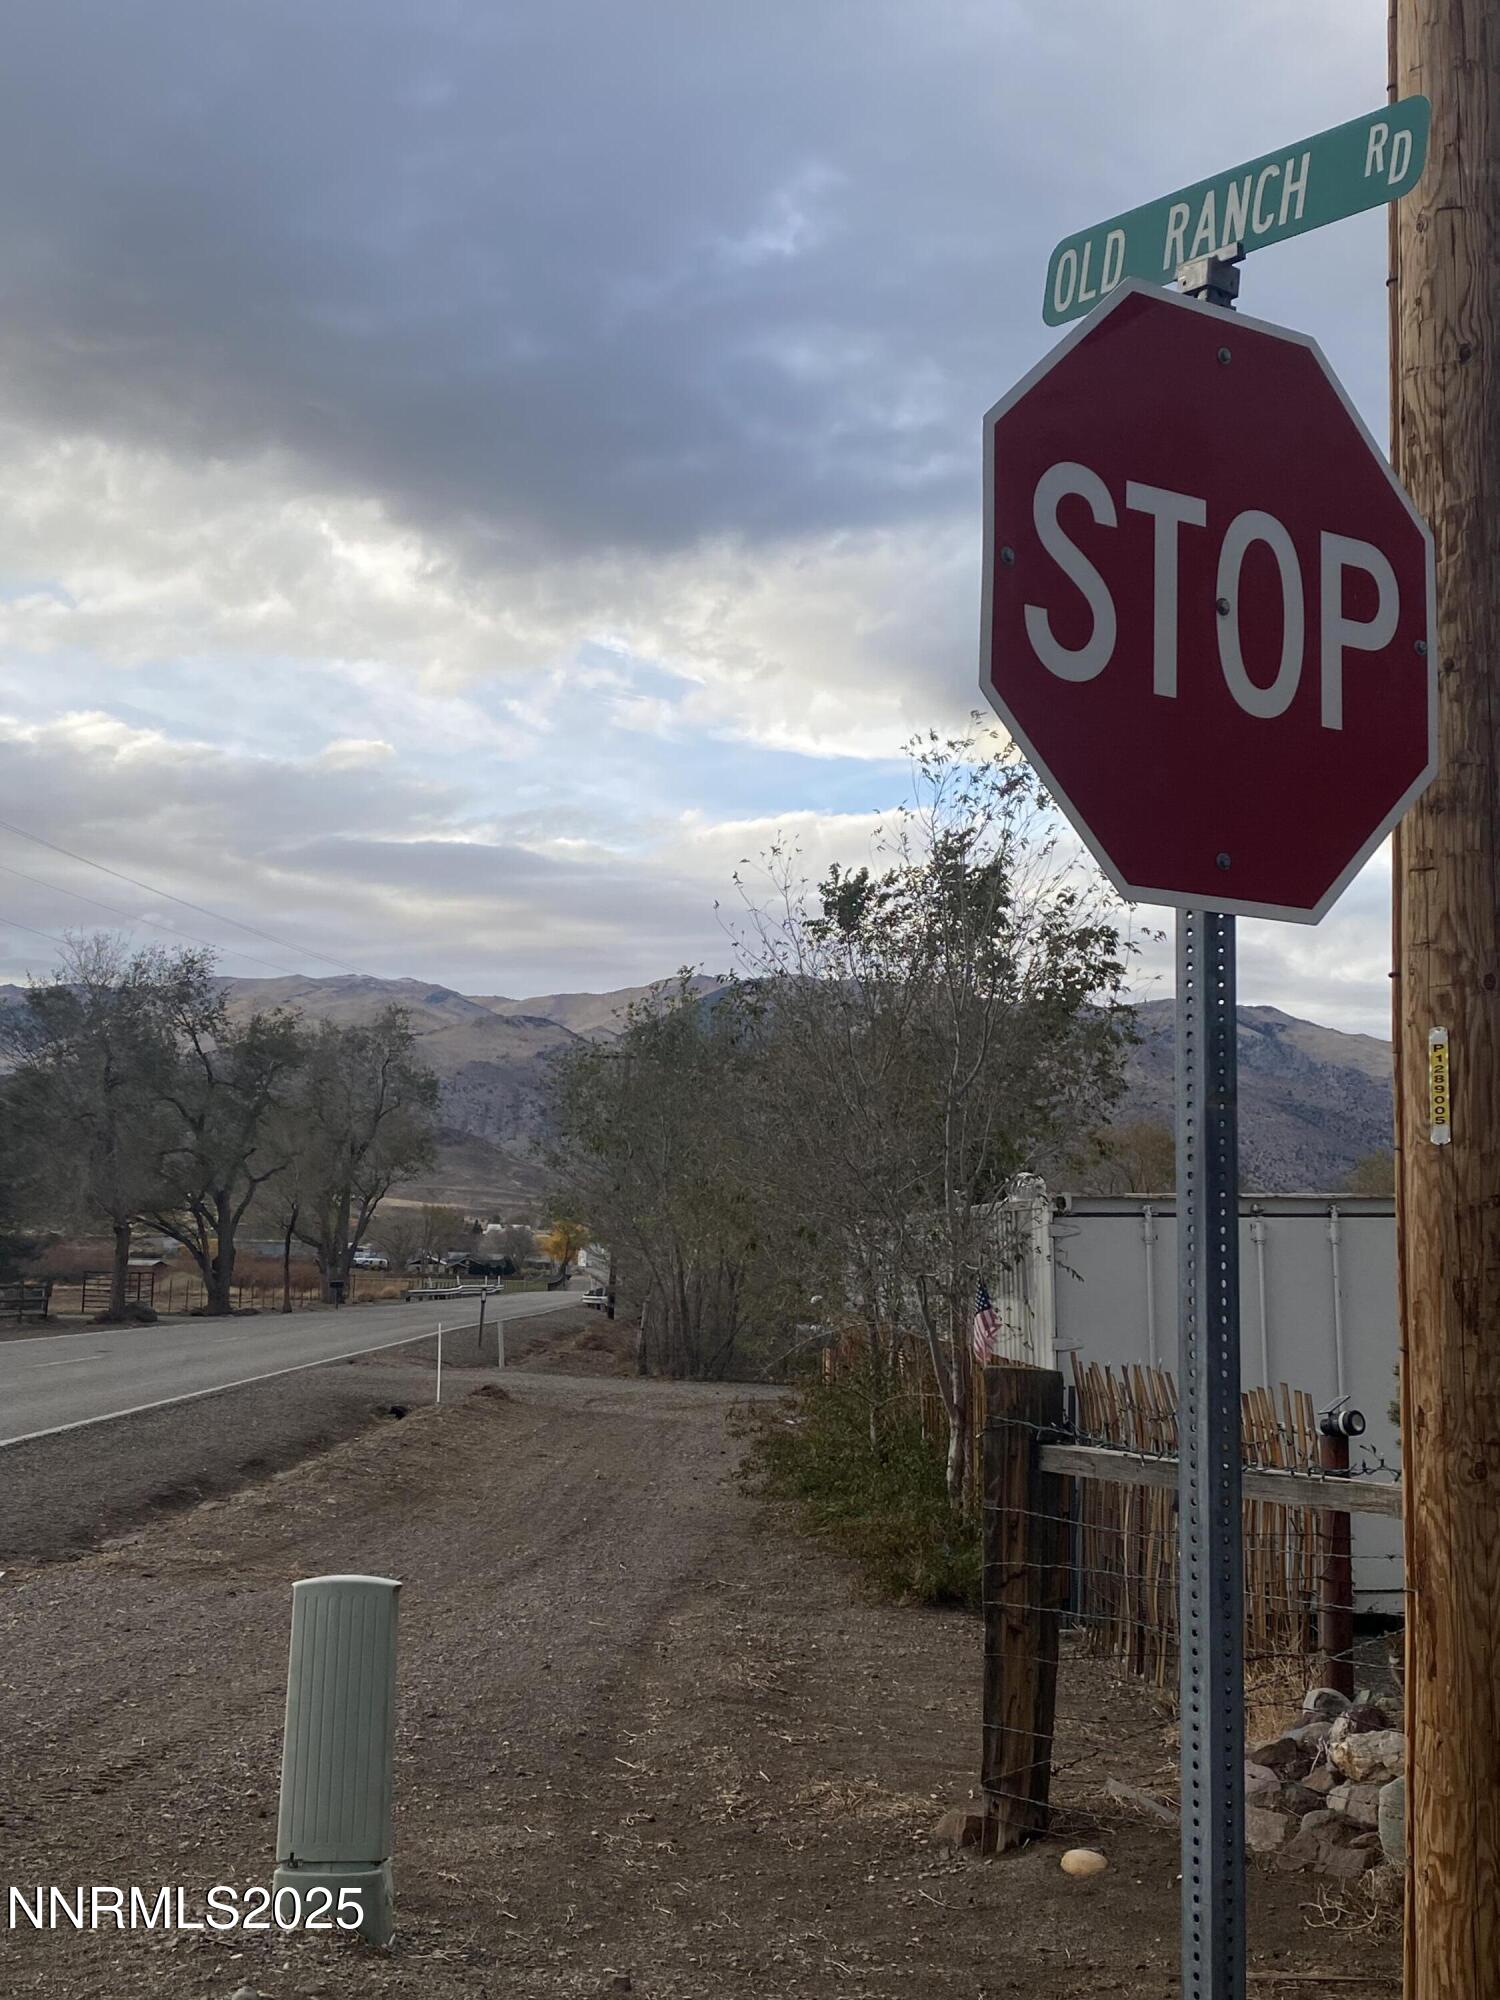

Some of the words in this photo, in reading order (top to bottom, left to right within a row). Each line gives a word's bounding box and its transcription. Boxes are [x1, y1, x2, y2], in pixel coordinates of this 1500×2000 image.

[1053, 228, 1126, 313] OLD
[1162, 151, 1311, 271] RANCH
[1364, 122, 1413, 186] RD
[1023, 460, 1401, 732] STOP
